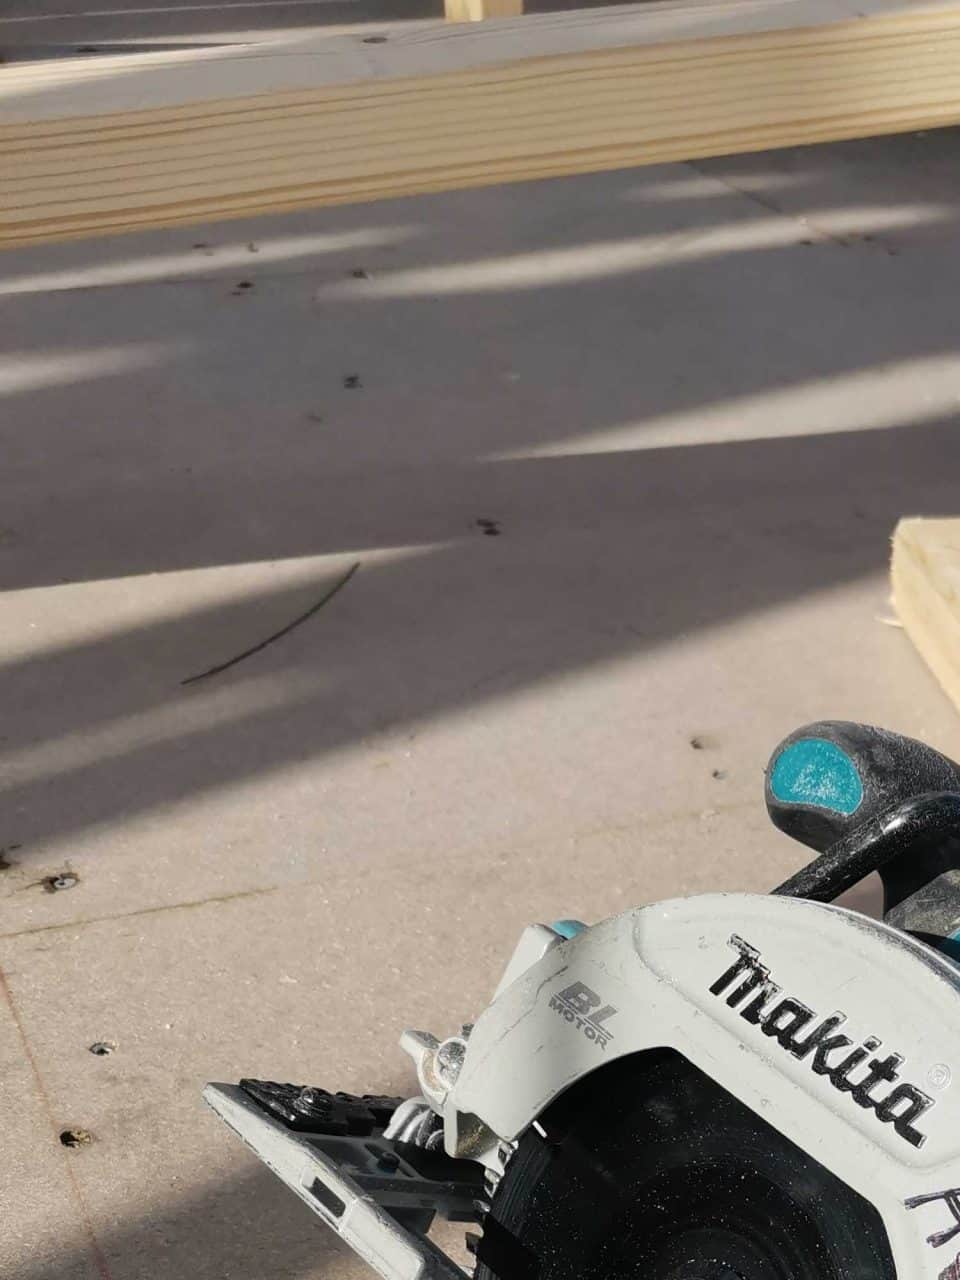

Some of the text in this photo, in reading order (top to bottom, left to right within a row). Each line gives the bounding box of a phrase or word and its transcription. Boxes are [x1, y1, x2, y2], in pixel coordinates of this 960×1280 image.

[548, 996, 607, 1051] MOTOR
[558, 980, 618, 1025] BL
[709, 932, 937, 1149] Makita
